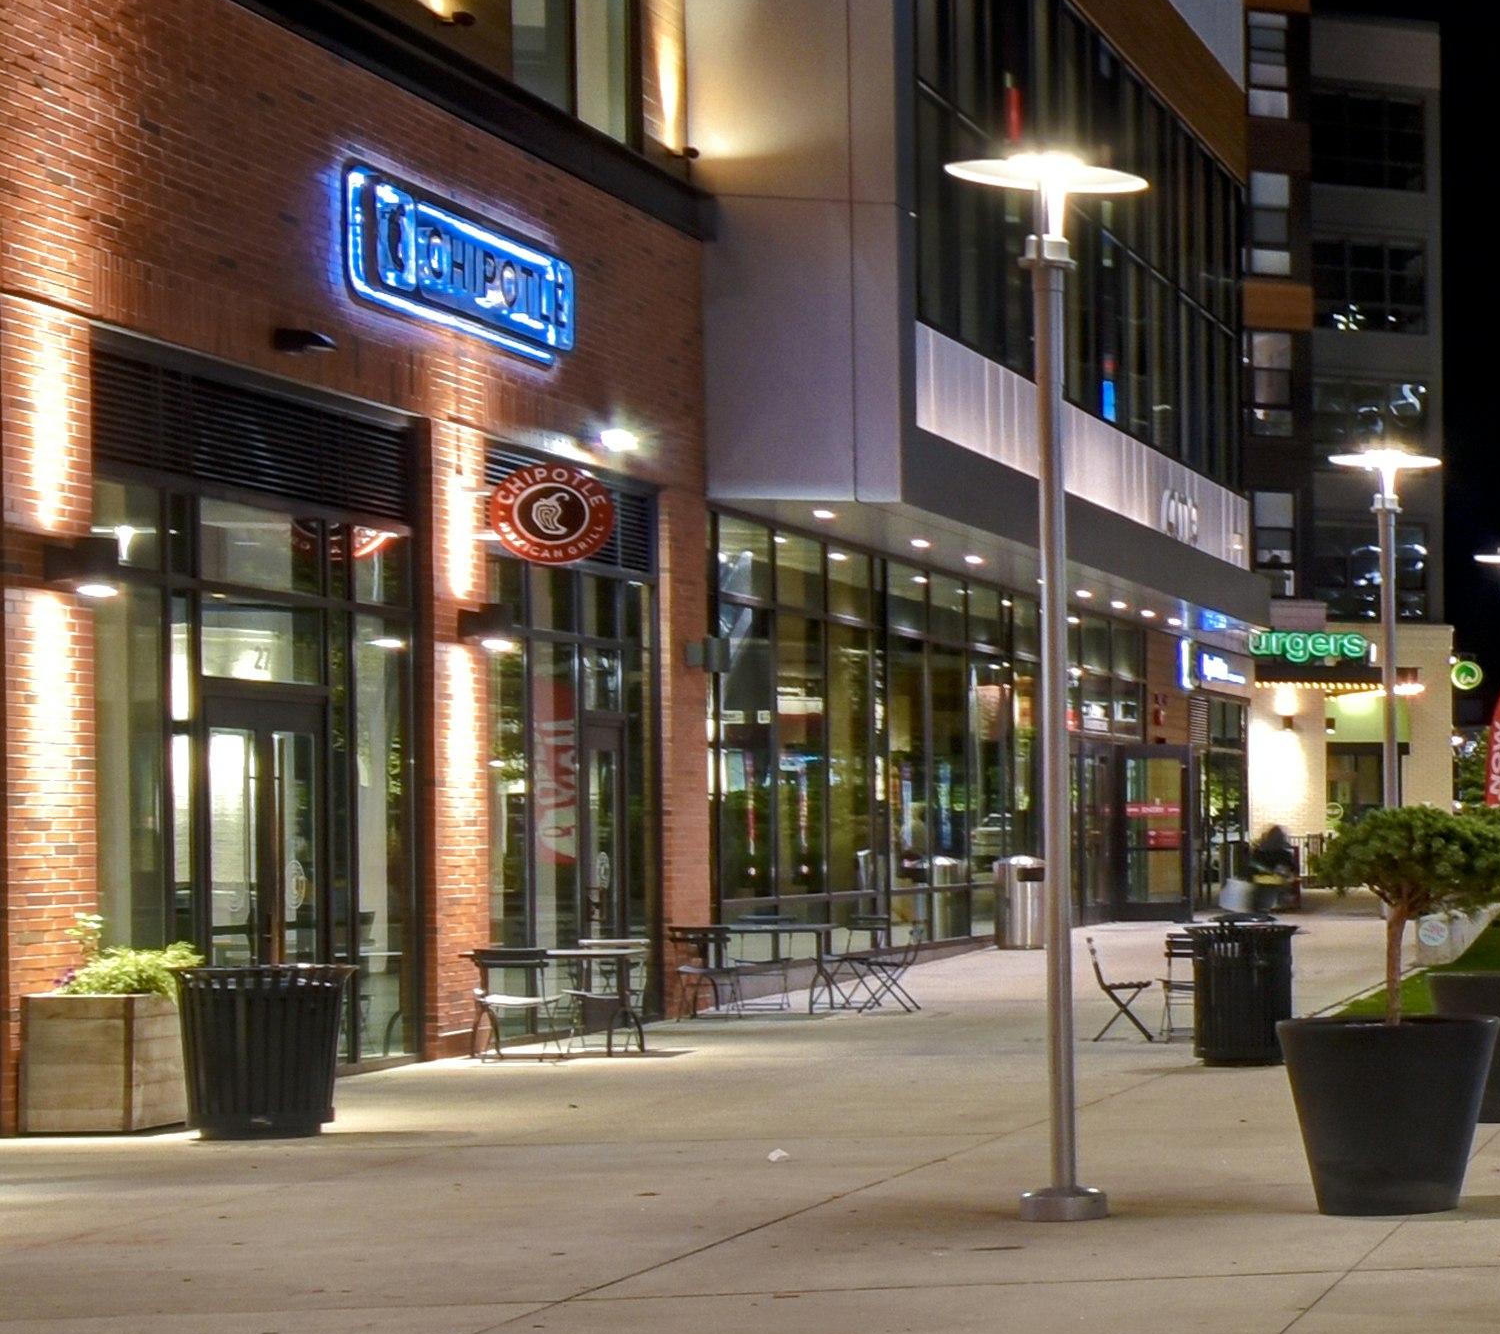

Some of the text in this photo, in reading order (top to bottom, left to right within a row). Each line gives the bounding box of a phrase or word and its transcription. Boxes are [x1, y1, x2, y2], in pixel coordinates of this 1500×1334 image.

[427, 227, 566, 329] CHIPOTLE
[497, 468, 607, 508] CHIPOTLE
[567, 525, 605, 555] GRILL
